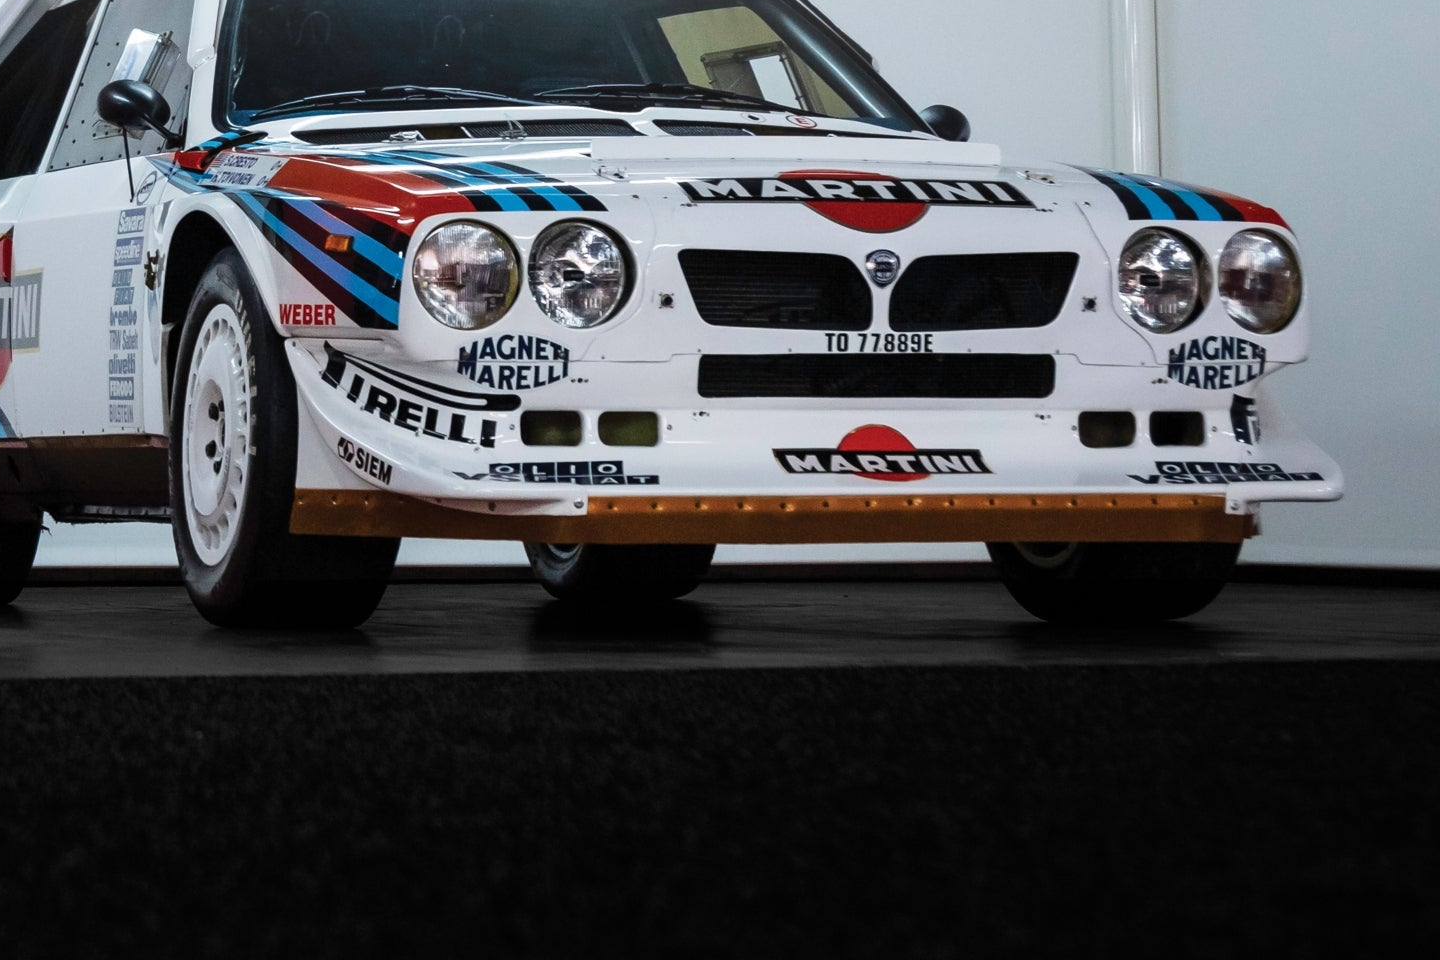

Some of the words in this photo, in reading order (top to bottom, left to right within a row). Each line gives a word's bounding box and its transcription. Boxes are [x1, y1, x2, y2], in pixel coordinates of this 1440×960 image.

[691, 179, 1017, 203] MARTINI
[119, 211, 144, 233] Savara
[115, 240, 141, 263] speedline
[109, 306, 138, 327] brembo
[279, 304, 336, 326] WEBER
[459, 334, 570, 360] MAGNETI
[825, 333, 848, 352] TO
[858, 333, 933, 353] 77889E
[109, 353, 136, 374] olivetti
[457, 361, 569, 390] MARELLI
[1167, 362, 1265, 390] MARELLI
[110, 380, 133, 397] FERODO
[321, 340, 520, 449] PIRELLI
[109, 404, 134, 423] BILSTEIN
[355, 448, 392, 485] SIEM
[494, 463, 618, 475] OLIO
[786, 455, 981, 473] MARTINI
[1161, 464, 1276, 473] OLIO
